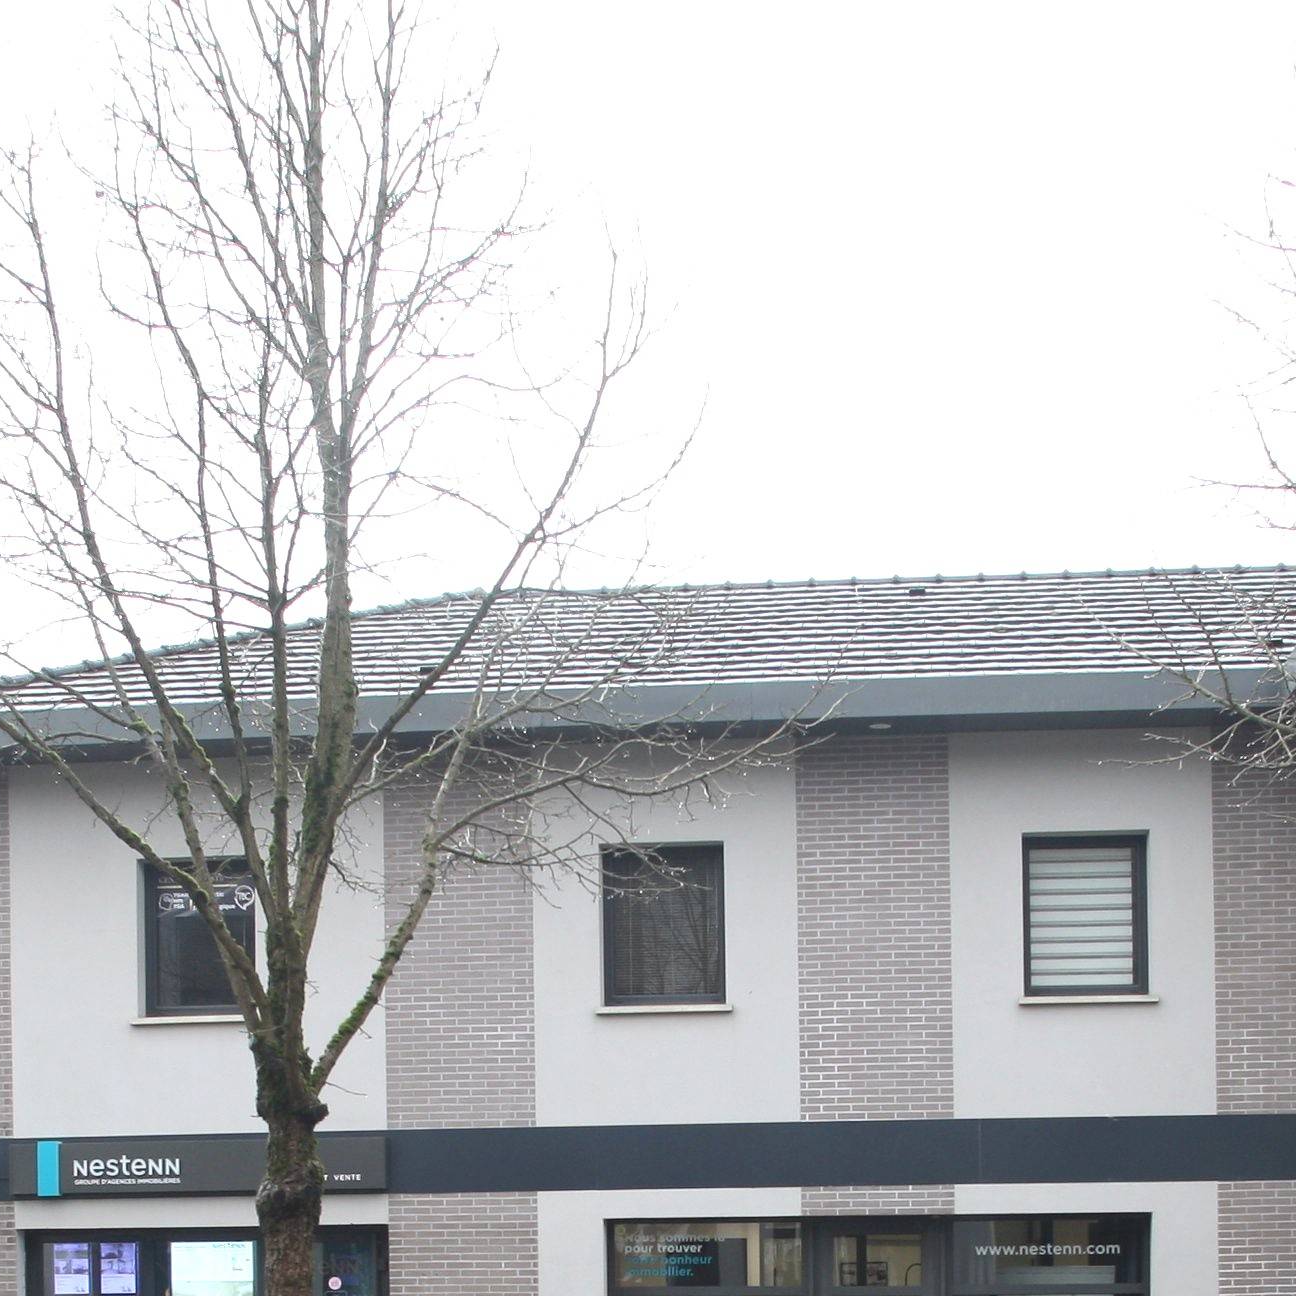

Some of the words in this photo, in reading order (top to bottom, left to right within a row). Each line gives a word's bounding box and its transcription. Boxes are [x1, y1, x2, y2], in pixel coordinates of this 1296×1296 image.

[333, 1173, 362, 1181] VENTE
[624, 1244, 653, 1256] pour
[657, 1241, 703, 1254] trouver
[975, 1243, 1120, 1256] www.nestenn.com
[663, 1254, 712, 1265] bonheur
